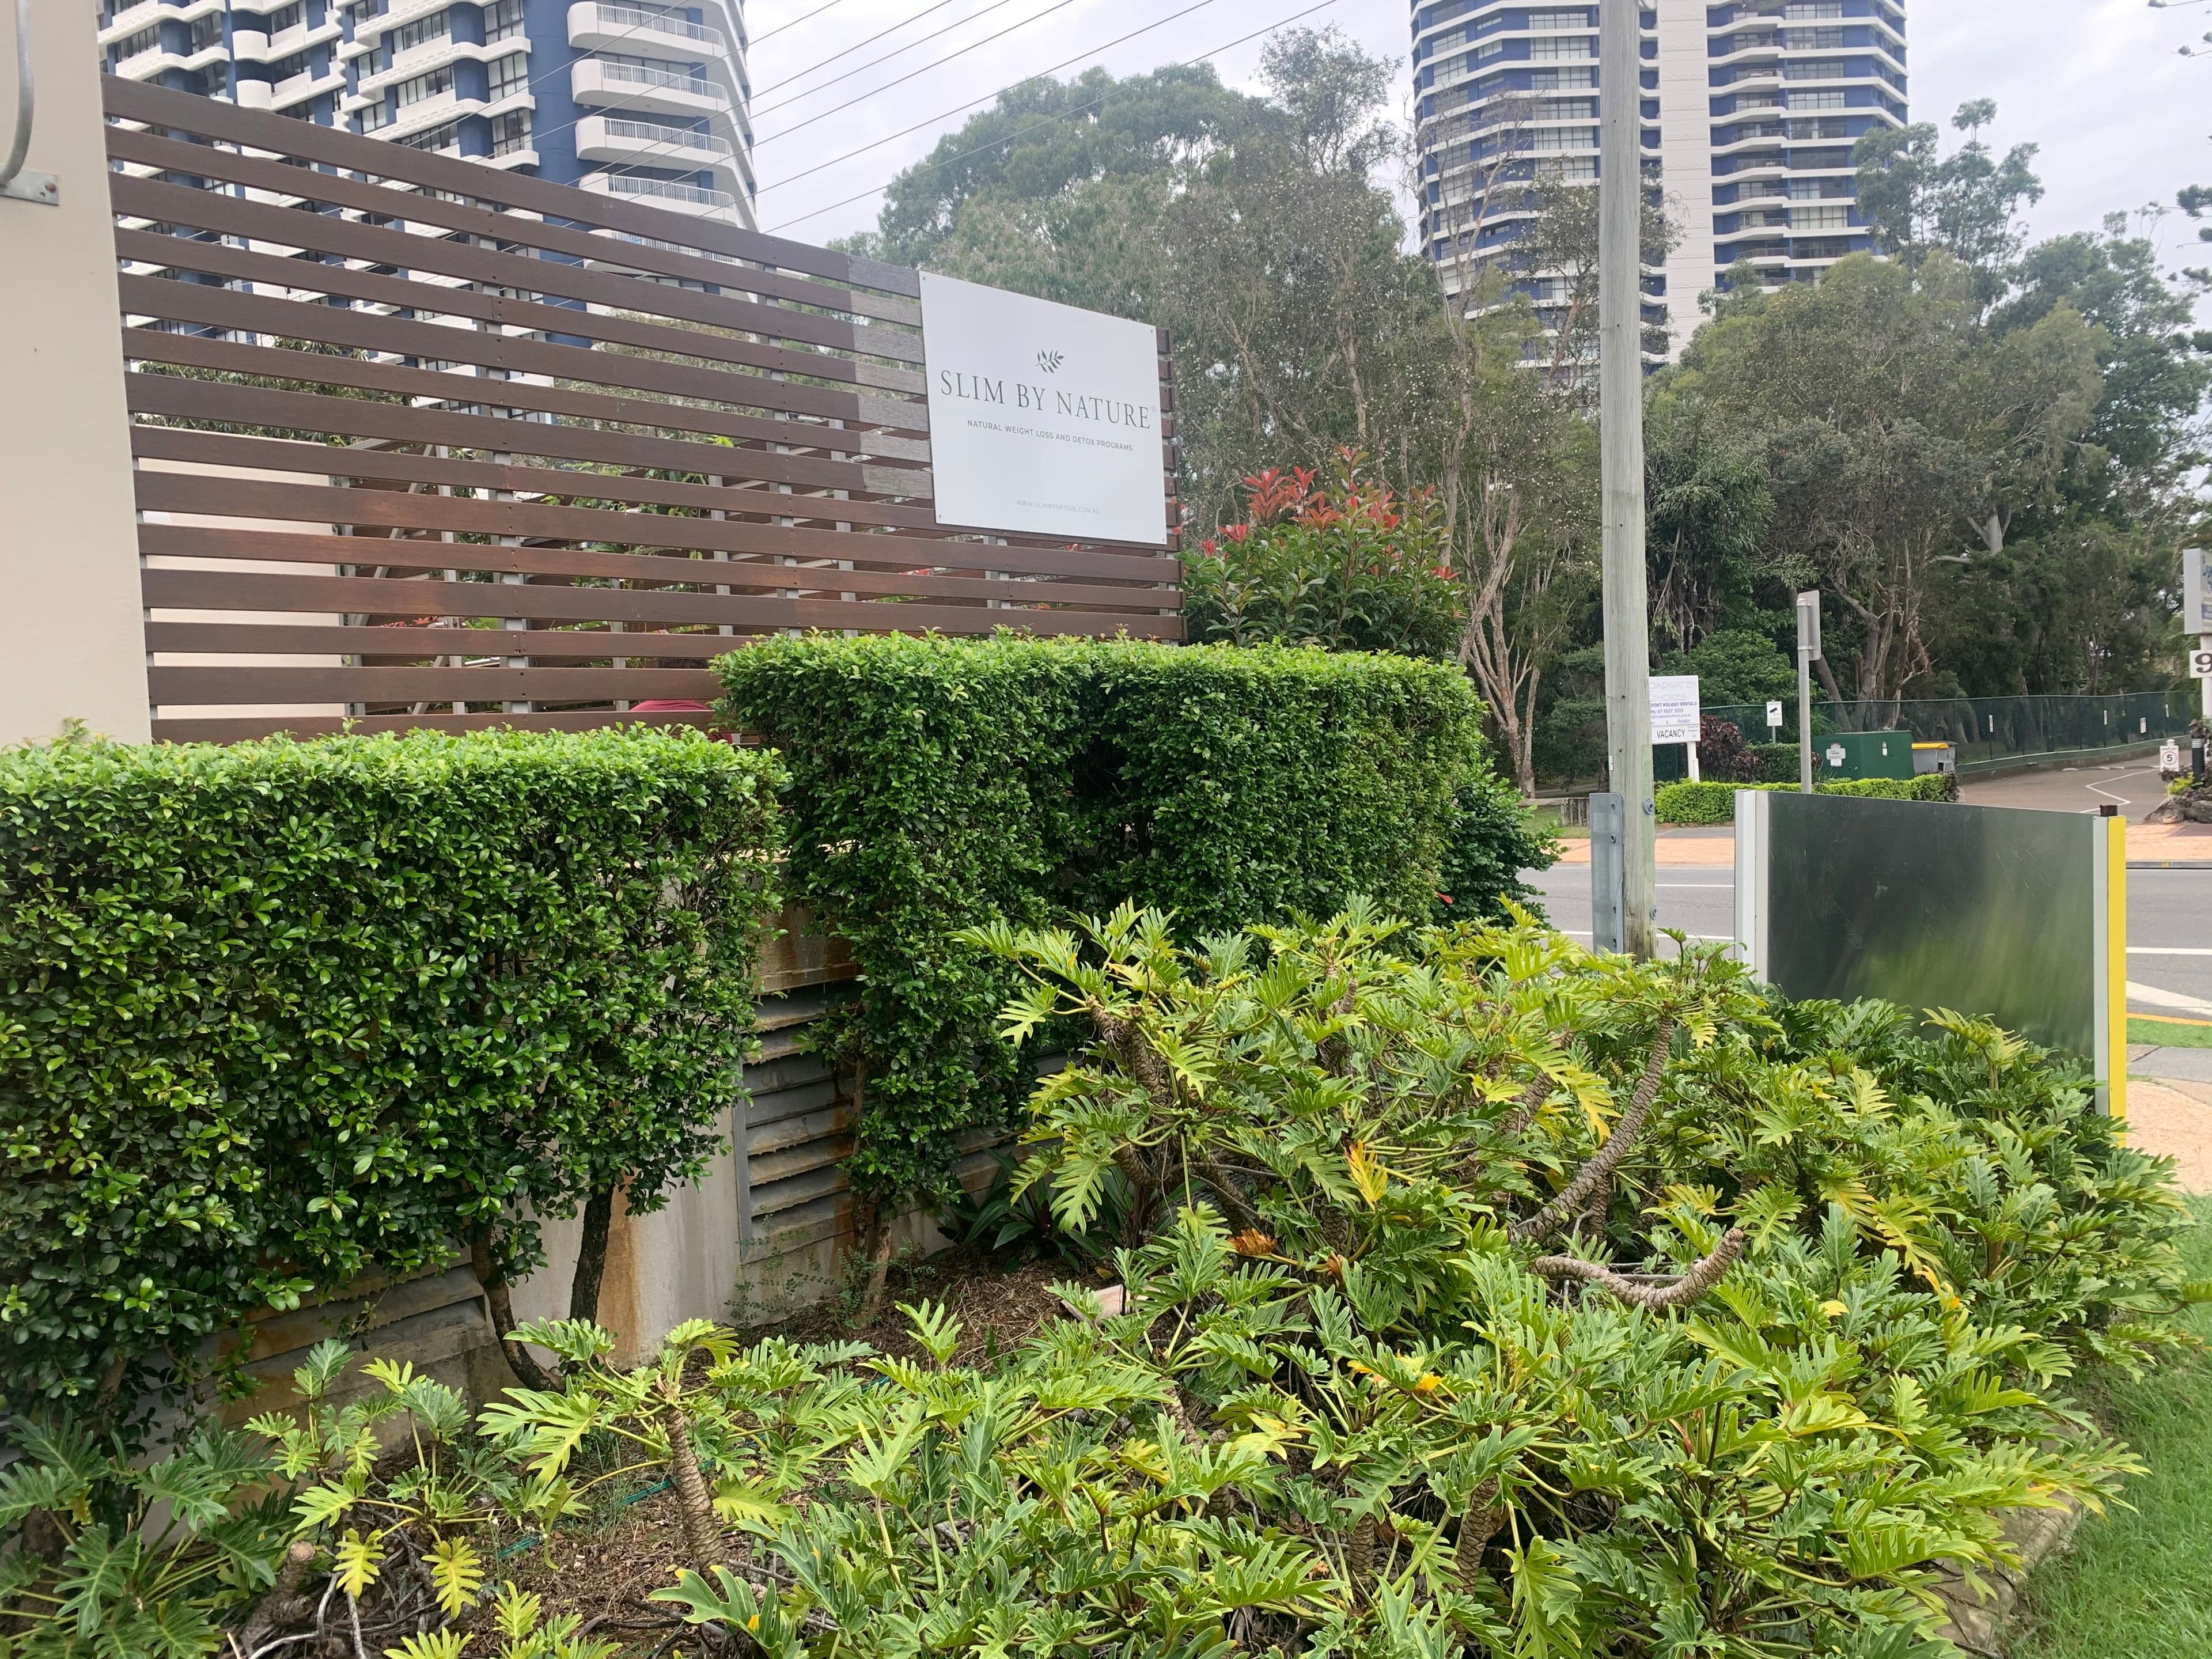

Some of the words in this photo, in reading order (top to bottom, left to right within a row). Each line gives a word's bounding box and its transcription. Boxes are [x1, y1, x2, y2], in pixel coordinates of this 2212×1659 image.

[941, 370, 1005, 404] SLIM
[1016, 383, 1046, 411] BY
[1055, 391, 1150, 429] NATURE
[967, 419, 1003, 432] NATURAL
[1005, 425, 1034, 437] WEIGHT
[1036, 430, 1054, 440] LOSS
[1055, 433, 1071, 442] AND
[1073, 436, 1095, 446] DETOX
[1097, 440, 1133, 452] PROGRAMS
[1657, 729, 1685, 738] VACANCY
